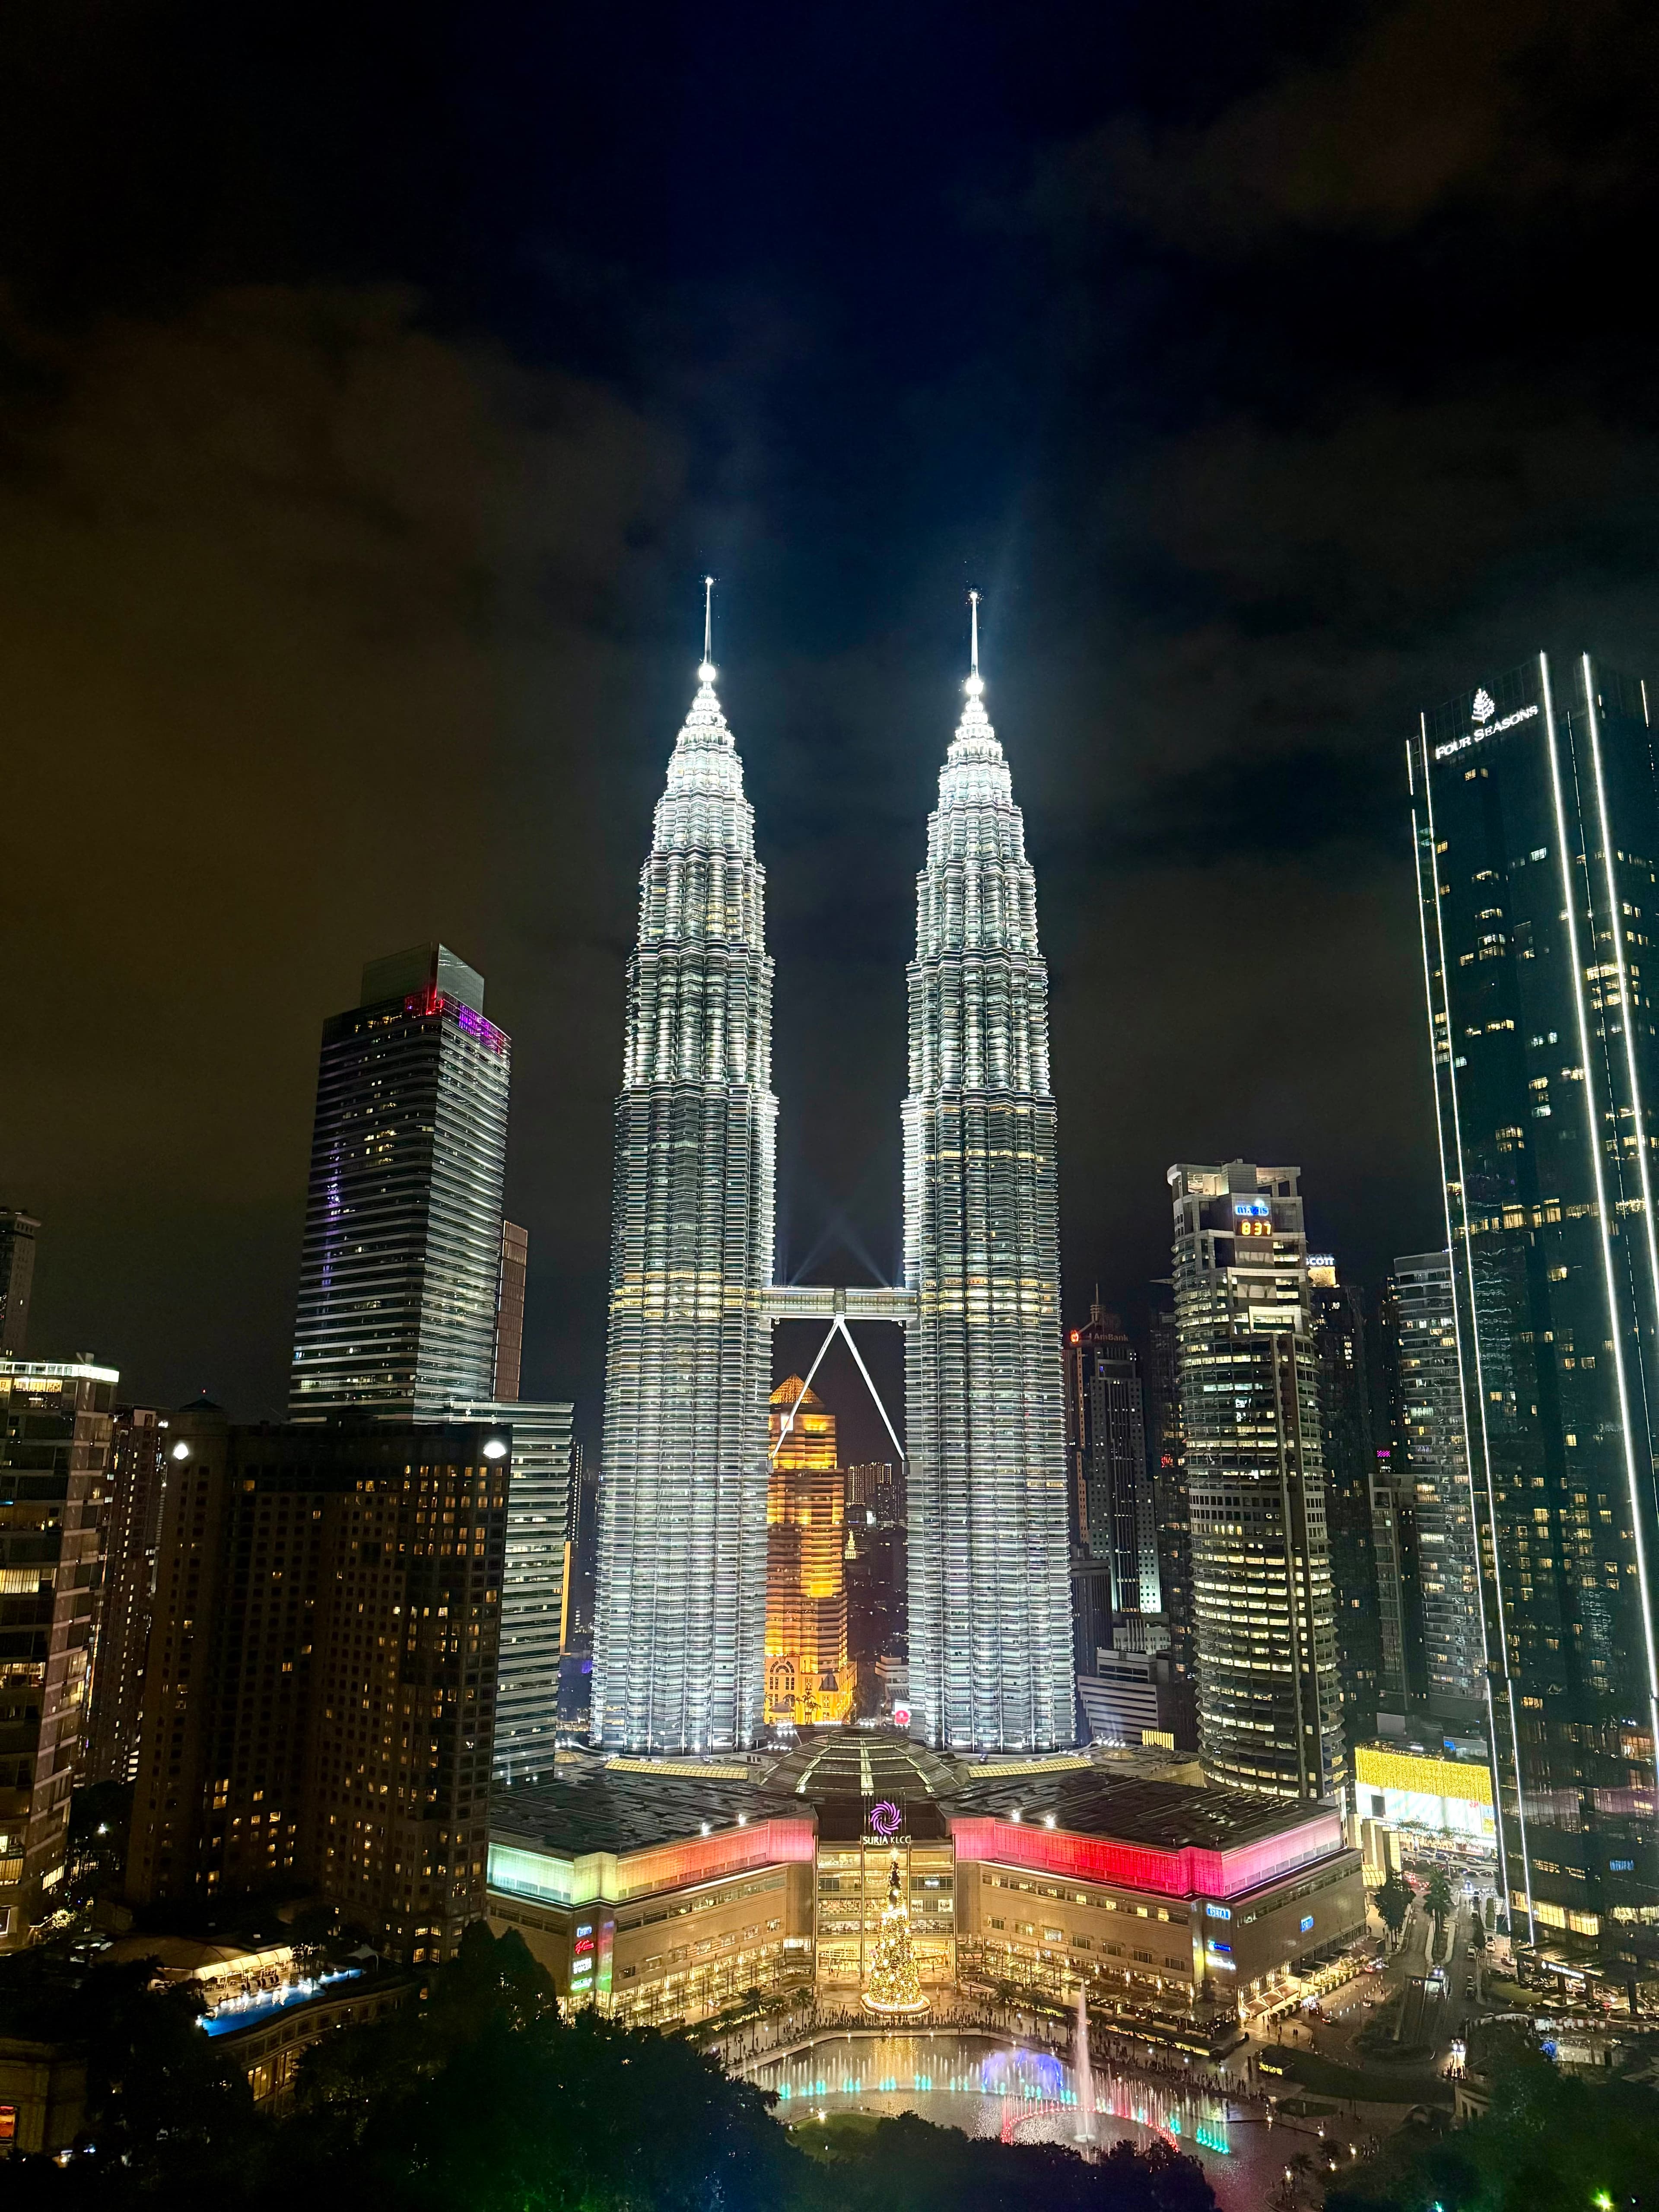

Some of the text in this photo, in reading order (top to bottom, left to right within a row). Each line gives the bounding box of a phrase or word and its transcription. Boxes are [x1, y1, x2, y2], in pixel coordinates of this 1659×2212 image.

[1436, 705, 1538, 760] FOUR SEASONS
[1094, 1333, 1129, 1341] AmBank
[863, 1836, 911, 1845] SURIA KLCC
